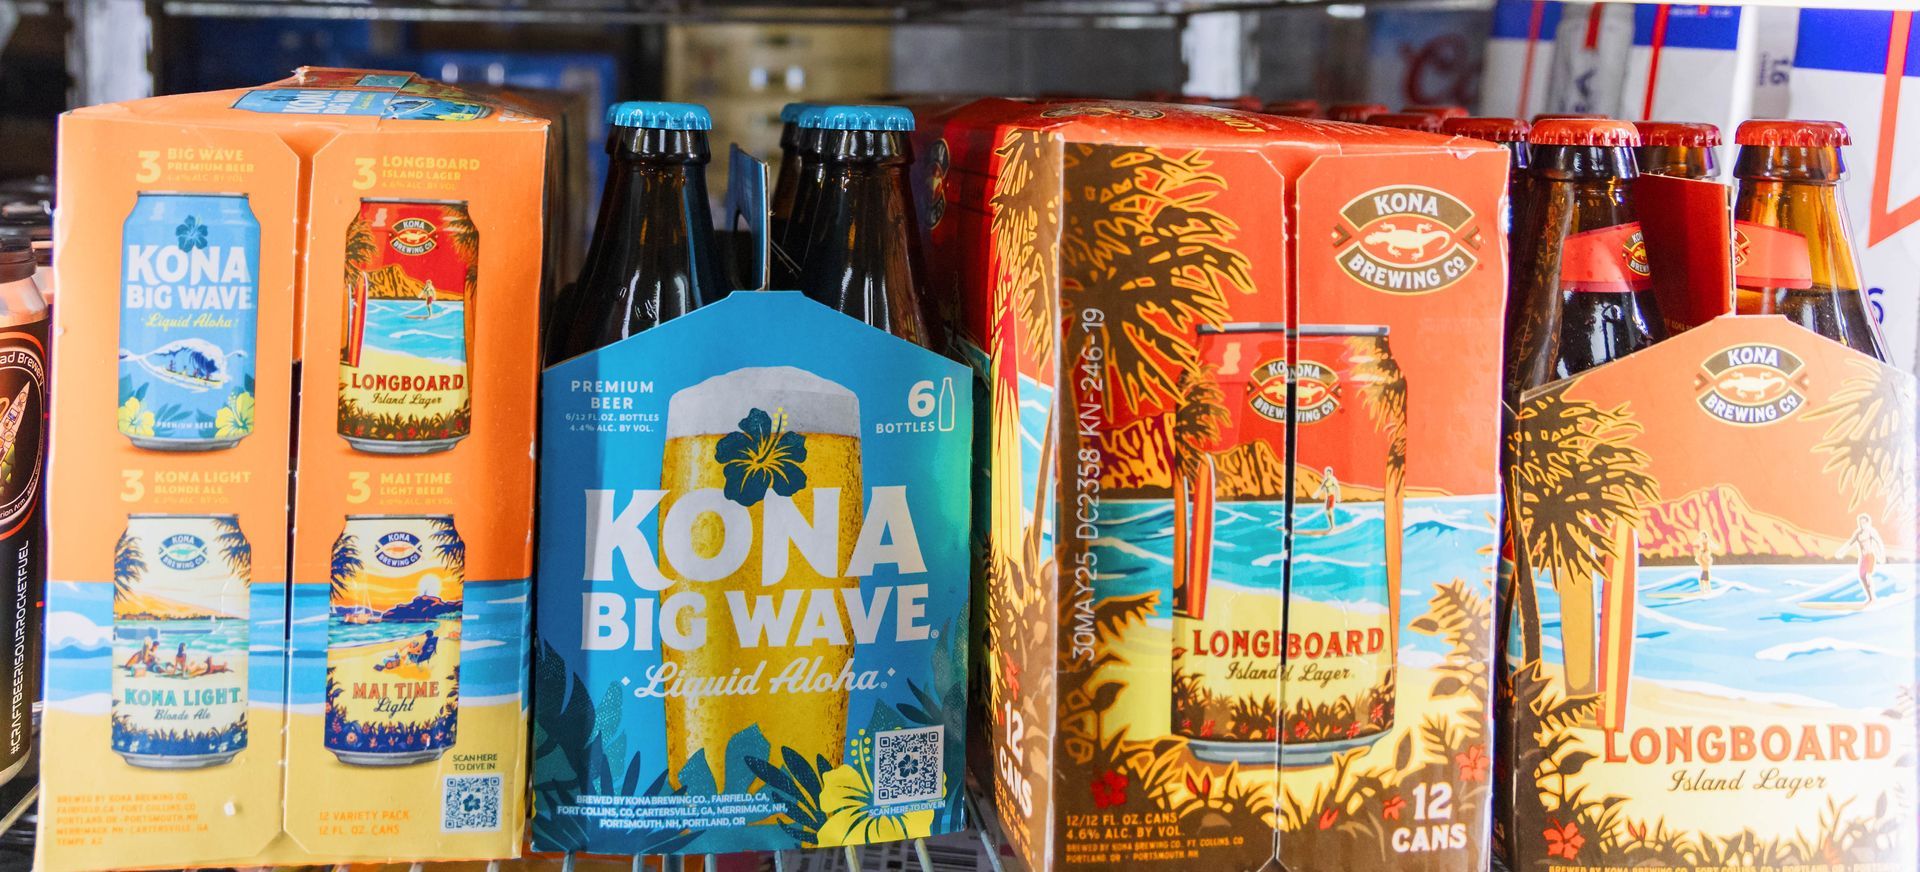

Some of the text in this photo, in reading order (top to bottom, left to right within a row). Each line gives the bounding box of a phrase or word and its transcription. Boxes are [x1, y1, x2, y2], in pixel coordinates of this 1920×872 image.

[167, 148, 243, 161] BIG WAVE
[136, 151, 160, 183] 3
[167, 162, 255, 173] PREMIUM BEER
[383, 156, 480, 171] LONGBOARD
[352, 157, 376, 190] 3
[382, 171, 461, 181] ISLAND LAGER
[1373, 193, 1439, 217] KONA
[402, 220, 425, 230] KONA
[392, 240, 424, 254] BREWING
[127, 245, 251, 285] KONA
[1347, 253, 1440, 290] BREWING
[126, 284, 252, 310] BIG WAVE
[145, 313, 232, 331] Liquid Aloha
[1727, 347, 1779, 368] KONA
[351, 373, 464, 392] LONGBOARD
[571, 380, 654, 393] PREMIUM
[372, 393, 442, 410] Island Lager
[591, 397, 633, 409] BEER
[907, 380, 935, 418] 6
[1705, 394, 1777, 422] BREWING
[157, 421, 193, 429] PREMIUM
[565, 413, 586, 421] 6/12
[619, 413, 660, 422] BOTTLES
[569, 424, 654, 432] 4.4% ALC. BY VOL.
[875, 421, 935, 434] BOTTLES
[154, 471, 251, 483] KONA LIGHT
[380, 472, 452, 485] MAI TIME
[1072, 308, 1104, 661] 30MAY25 DC2358 KN-246-19
[120, 469, 145, 502] 3
[154, 485, 223, 494] BLONDE ALE
[346, 471, 371, 504] 3
[379, 486, 444, 496] LIGHT BEER
[171, 535, 194, 544] KONA
[387, 533, 410, 543] KONA
[582, 485, 928, 591] KONA
[162, 556, 195, 570] BREWING
[378, 553, 410, 567] BREWING
[580, 591, 708, 651] BIG
[11, 539, 29, 756] #CRAFTBEERISOURROCKETFUEL
[1298, 663, 1350, 688] Lager
[352, 681, 439, 699] MAI TIME
[633, 659, 761, 710] Liquid
[124, 687, 241, 707] KONA LIGHT
[154, 708, 211, 722] Blonde Ale
[373, 697, 415, 719] Light
[1004, 699, 1024, 766] 12
[1602, 722, 1892, 765] LONGBOARD
[452, 753, 498, 762] SCAN HERE
[454, 762, 496, 771] TO DIVE IN
[1000, 746, 1033, 818] CANS
[1667, 768, 1827, 799] Island Lager
[576, 795, 613, 805] BREWED
[613, 796, 625, 805] BY
[625, 796, 651, 804] KONA
[651, 795, 693, 804] BREWING
[711, 793, 754, 803] FAIRFIELD,
[755, 792, 770, 802] CA,
[1412, 782, 1453, 820] 12
[333, 811, 378, 821] VARIETY
[382, 810, 410, 820] PACK
[557, 803, 788, 817] FORT COLLINS, CO, CARTERSVILLE, GA, MERRIMACK, NH,
[868, 800, 946, 817] SCAN HERE TO DIVE IN
[600, 817, 746, 829] PORTSMOUTH, NH, PORTLAND, OR
[1066, 815, 1098, 827] 12/12
[1145, 813, 1177, 825] CANS
[372, 825, 400, 836] CANS
[1066, 826, 1185, 840] 4.6% ALC. BY VOL.
[1392, 823, 1467, 853] CANS
[1066, 843, 1099, 852] BREWED
[1134, 841, 1168, 850] BREWING
